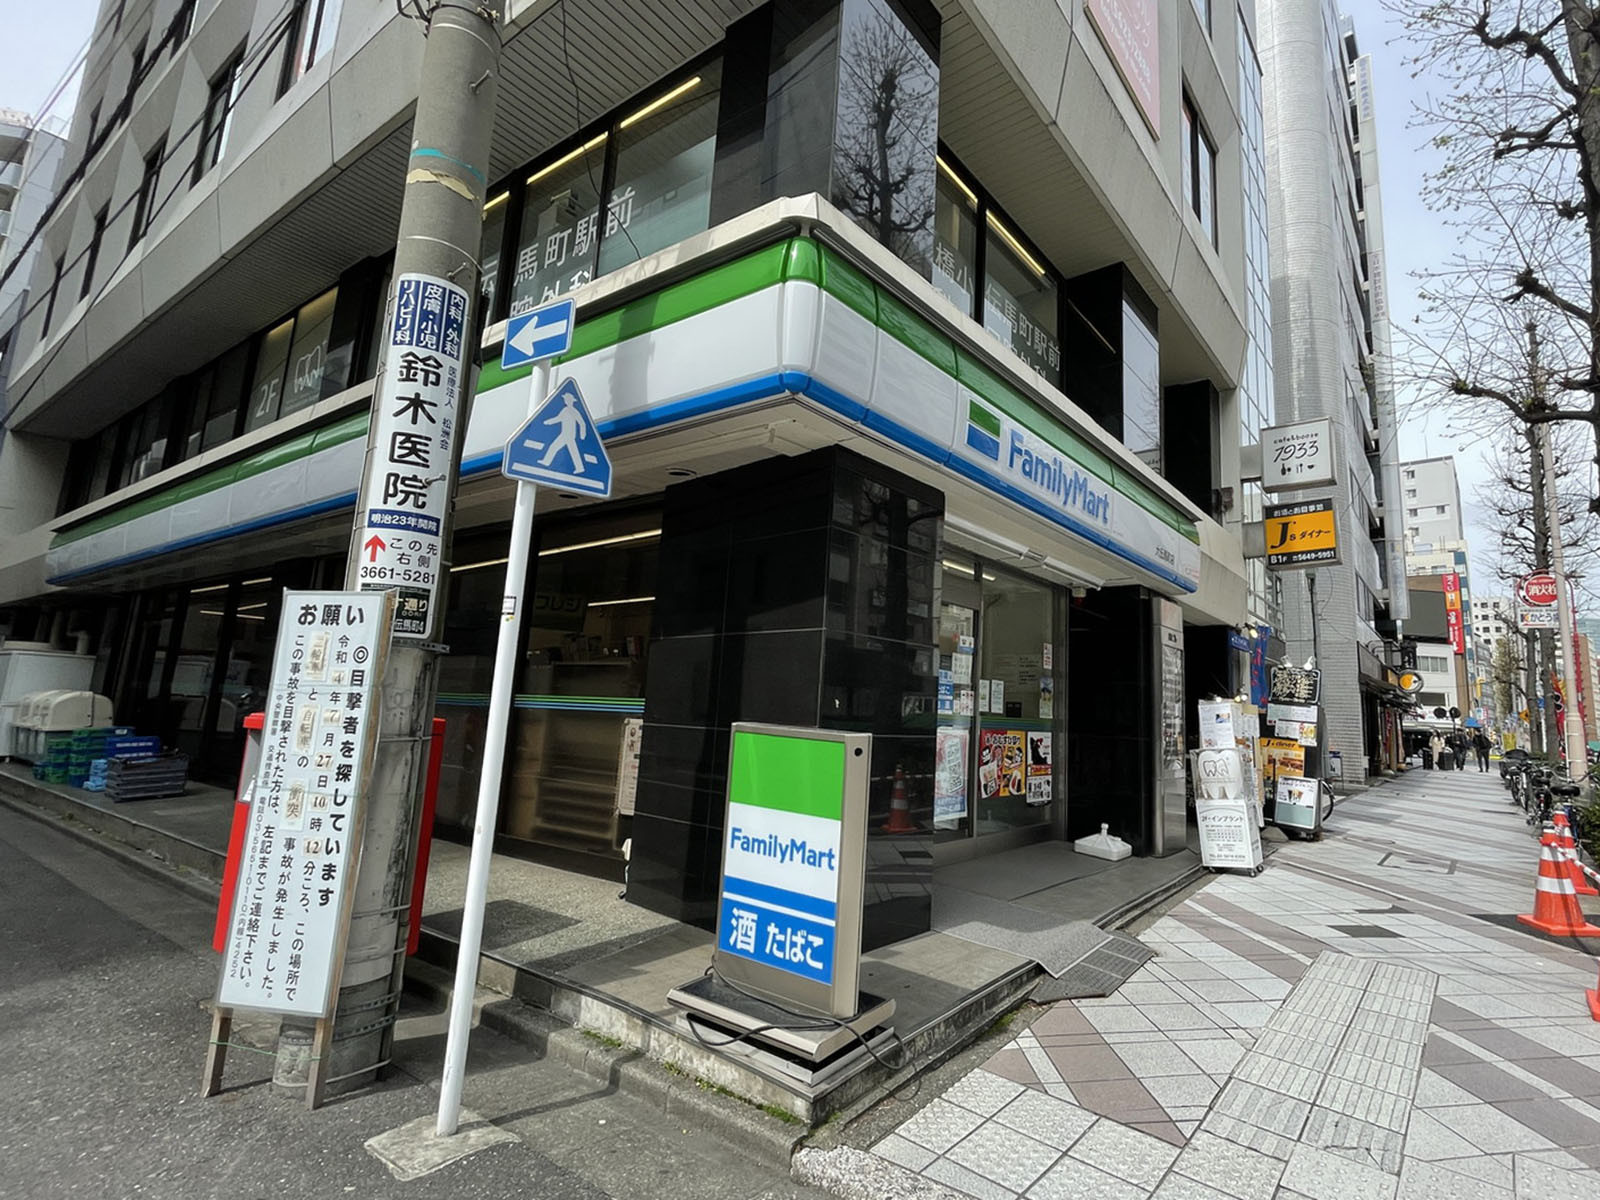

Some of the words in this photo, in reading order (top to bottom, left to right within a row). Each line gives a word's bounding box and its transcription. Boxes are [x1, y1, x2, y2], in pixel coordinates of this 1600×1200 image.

[394, 281, 416, 344] リハビリ科
[255, 377, 281, 418] 2F
[382, 351, 444, 510] 鈴木医院
[1273, 440, 1319, 463] 1933
[1008, 428, 1111, 525] FamilyMart
[390, 537, 438, 556] この先
[1299, 529, 1332, 541] ダイナー
[360, 566, 436, 585] 3661-5281
[397, 552, 431, 569] 右側
[297, 602, 365, 628] お願い
[730, 827, 836, 872] FamilyMart
[729, 907, 758, 955] 酒
[764, 921, 825, 971] たばこ
